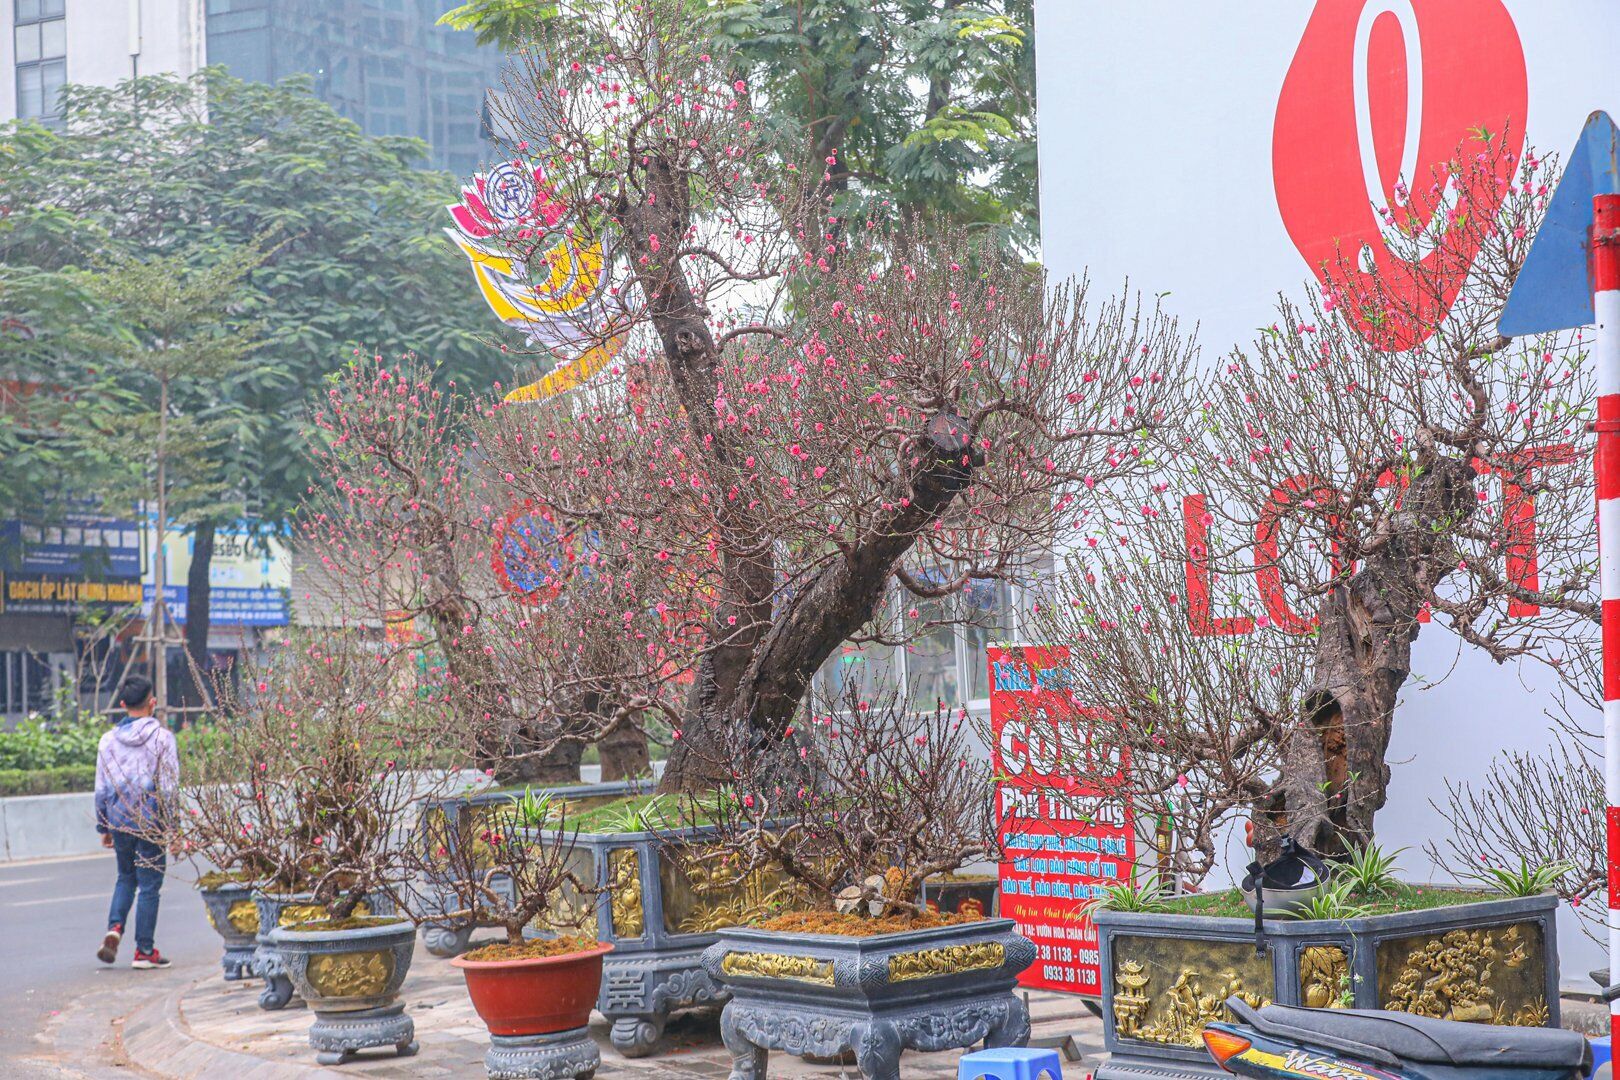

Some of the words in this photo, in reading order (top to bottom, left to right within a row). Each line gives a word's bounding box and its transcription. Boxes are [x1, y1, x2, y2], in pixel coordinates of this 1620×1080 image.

[57, 577, 76, 601] LÁT
[1001, 787, 1040, 819] Phú
[1044, 787, 1125, 829] Thượng
[1030, 834, 1046, 851] CHO
[1014, 855, 1030, 872] CÁC
[1031, 857, 1047, 877] LOẠI
[1049, 856, 1065, 873] ĐÀO
[1089, 855, 1100, 877] CỔ
[1101, 862, 1117, 880] THỤ
[1002, 876, 1018, 894] ĐÀO
[1018, 876, 1035, 897] THẾ,
[1035, 879, 1051, 896] ĐÀO
[1052, 879, 1073, 900] BÍCH,
[1035, 923, 1053, 938] VƯỜN
[1053, 926, 1065, 939] HOA
[1041, 945, 1051, 960] 38
[1052, 945, 1072, 963] 1138
[1079, 948, 1099, 966] 0985
[1043, 964, 1063, 981] 0933
[1064, 967, 1075, 983] 38
[1076, 968, 1096, 985] 1138
[1333, 1060, 1363, 1072] HONDA
